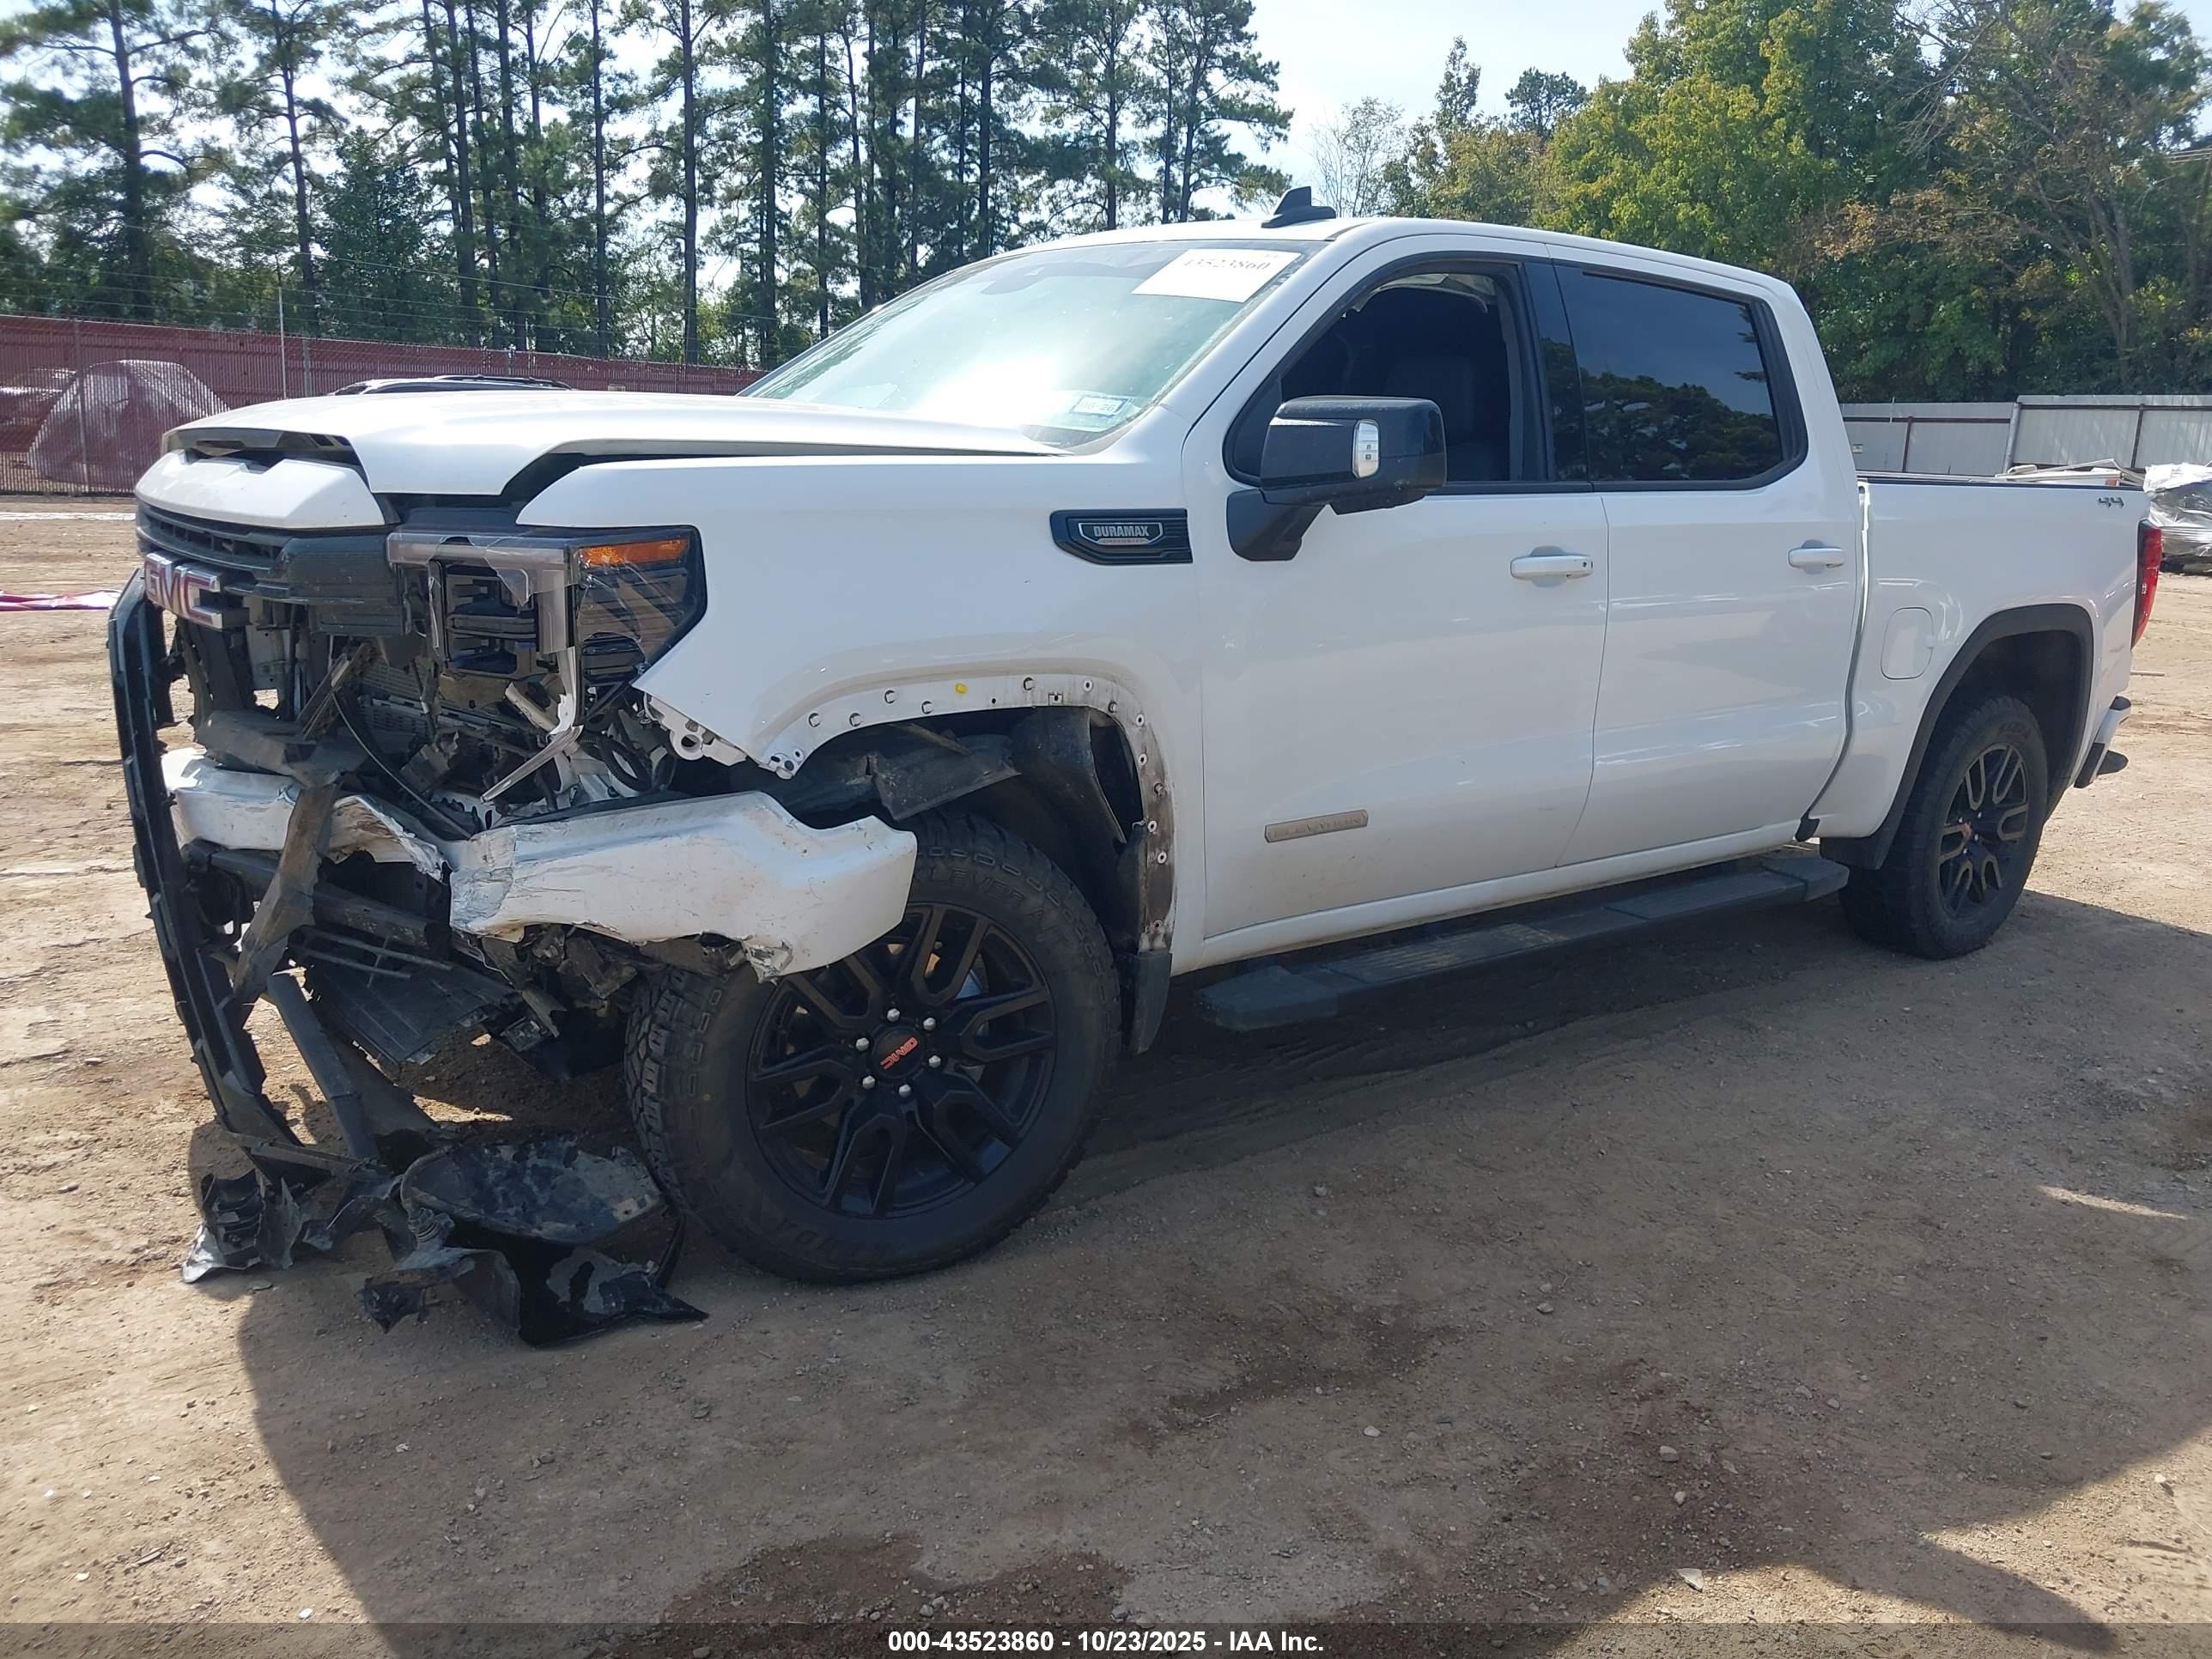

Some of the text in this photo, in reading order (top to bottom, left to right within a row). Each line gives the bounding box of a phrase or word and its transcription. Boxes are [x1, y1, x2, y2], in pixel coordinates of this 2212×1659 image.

[1093, 526, 1150, 537] DURAMAX
[144, 549, 223, 632] GMC
[879, 1036, 918, 1071] GMC
